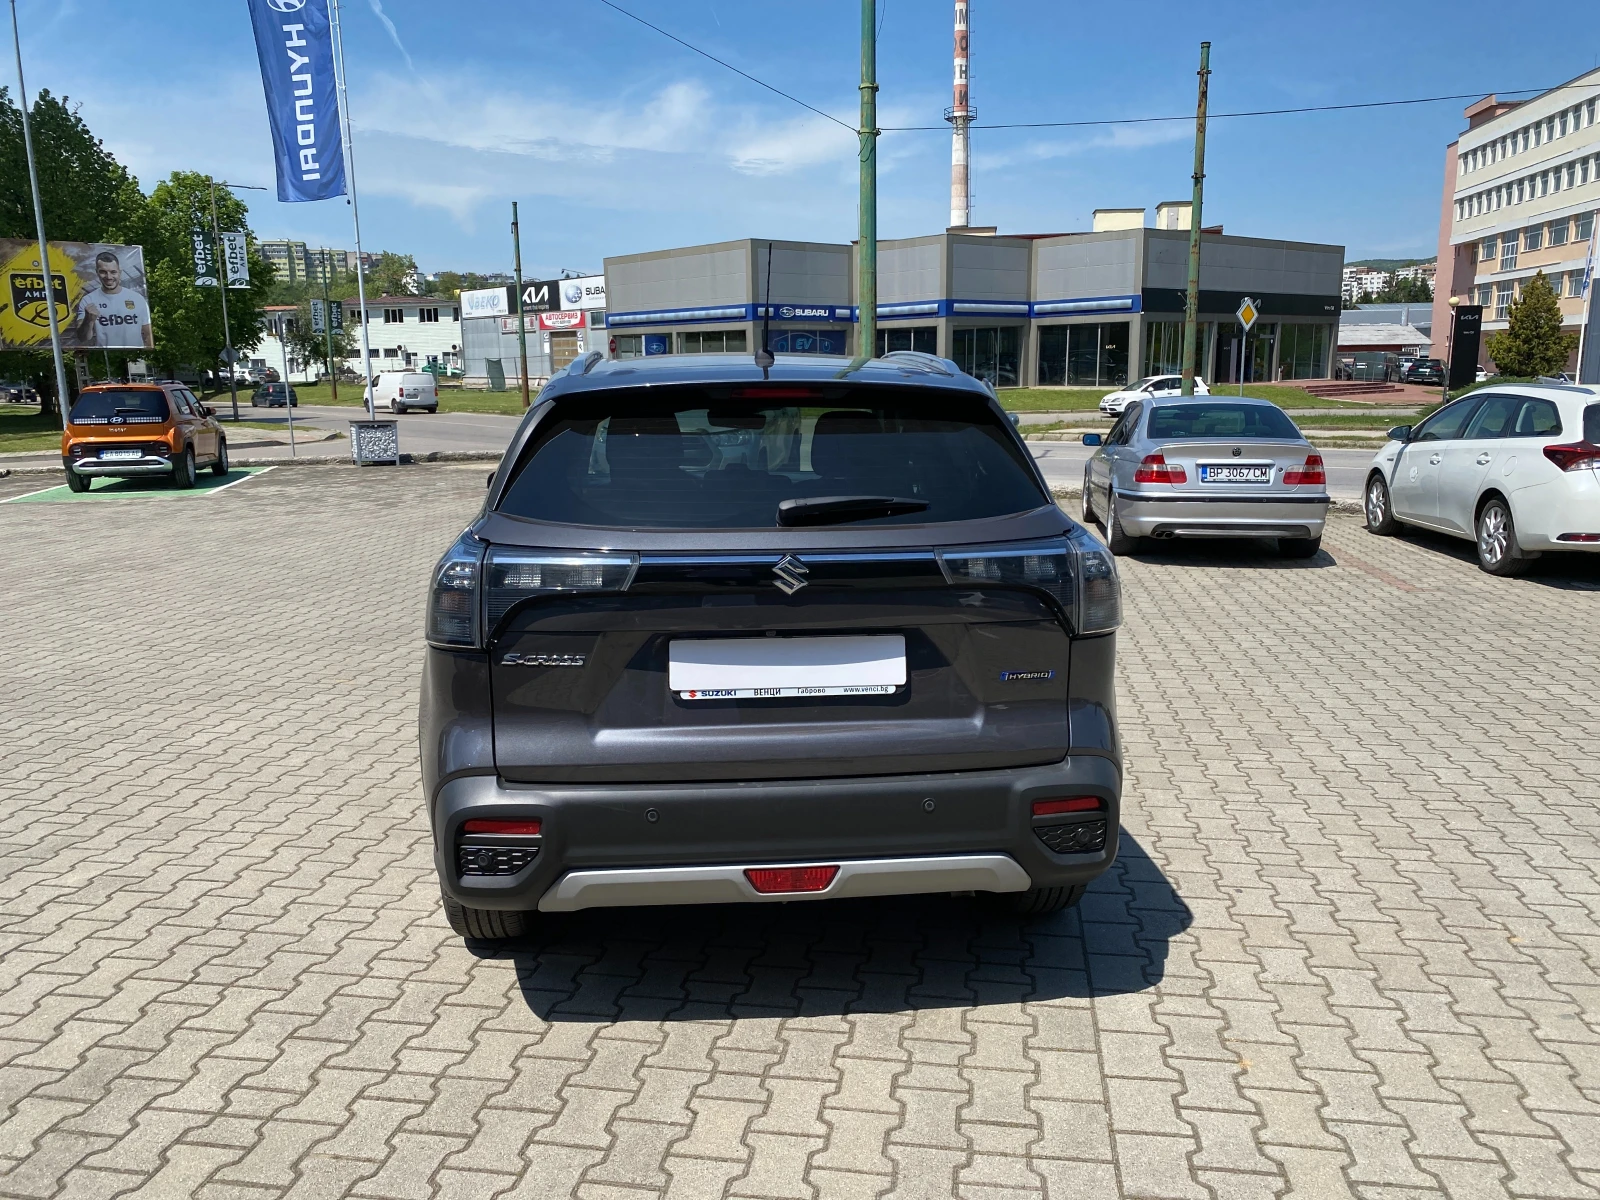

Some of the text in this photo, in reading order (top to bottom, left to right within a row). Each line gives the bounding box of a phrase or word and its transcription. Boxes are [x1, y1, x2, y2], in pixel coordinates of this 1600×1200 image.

[282, 23, 321, 182] HYUNDAI
[192, 234, 206, 274] efbet
[226, 236, 239, 275] efbet
[13, 277, 63, 290] efbt
[585, 286, 606, 296] SUBA
[545, 312, 578, 321] АВТОСЕРВИЗ
[795, 308, 829, 317] SUBARU
[97, 314, 138, 326] efbet
[795, 338, 813, 349] EV
[1209, 467, 1267, 478] BP 3067 CM
[1009, 672, 1048, 680] HYBRID
[753, 687, 826, 696] ВЕНЦИ Габрово
[843, 685, 889, 693] www.venci.bg
